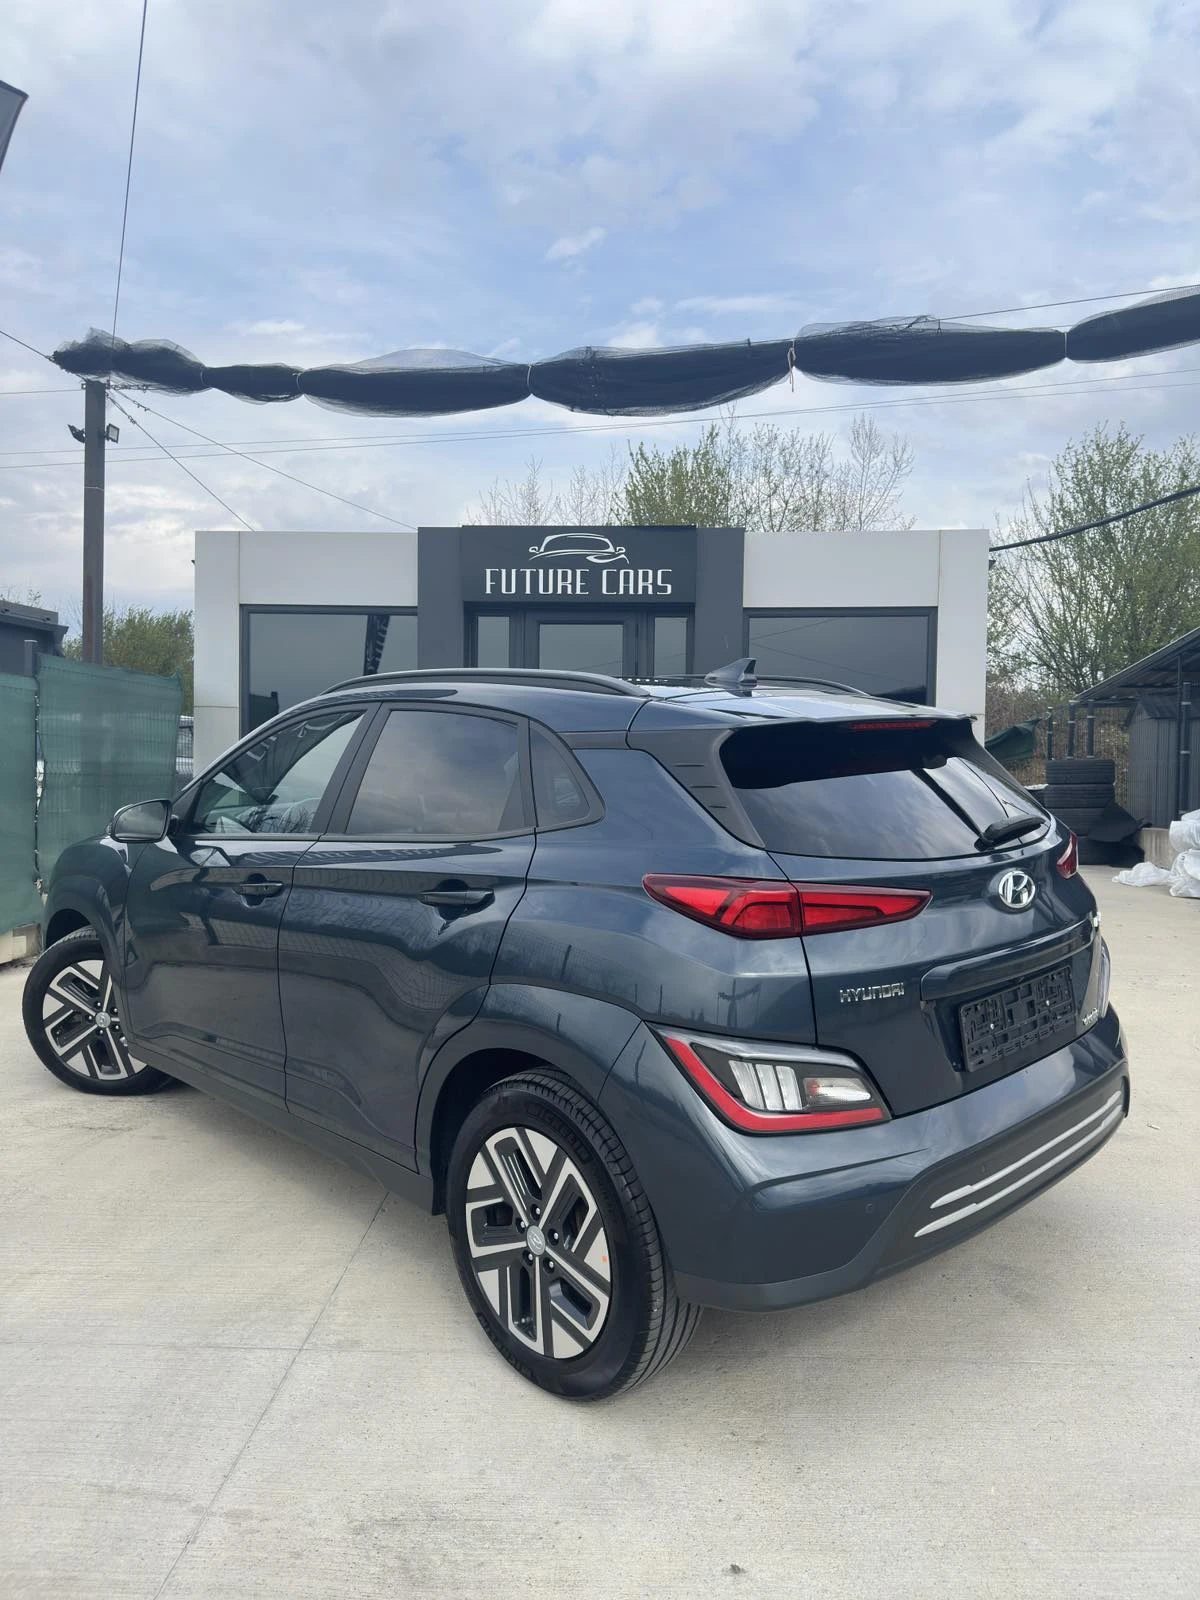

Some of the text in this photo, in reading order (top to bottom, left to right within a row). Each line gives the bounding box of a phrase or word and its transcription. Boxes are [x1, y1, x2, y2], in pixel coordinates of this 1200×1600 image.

[485, 568, 673, 596] FUTURE CARS
[839, 982, 905, 1003] HYUNDAI
